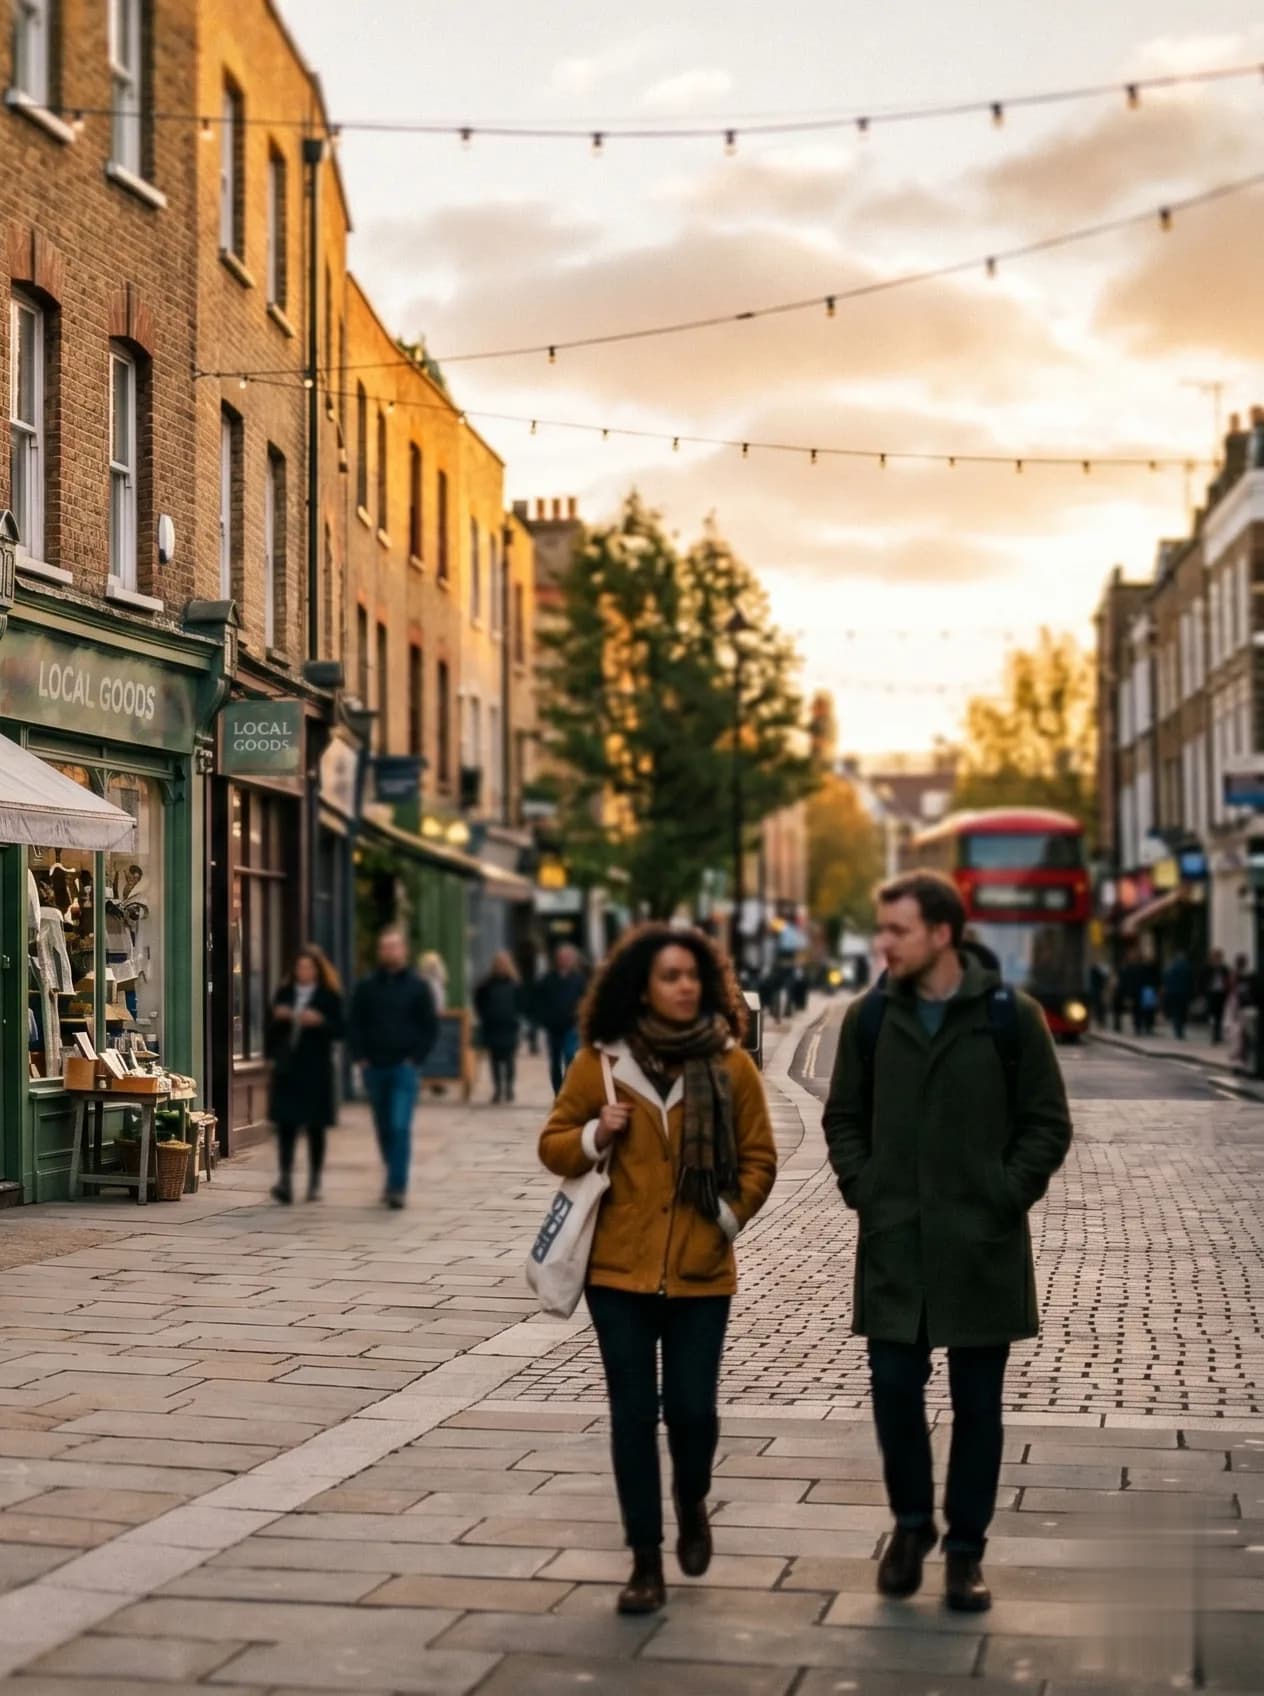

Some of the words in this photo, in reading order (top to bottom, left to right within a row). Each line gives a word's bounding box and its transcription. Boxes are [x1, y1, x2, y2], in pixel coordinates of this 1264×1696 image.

[38, 661, 95, 709] LOCAL
[99, 677, 156, 721] GOODS
[233, 722, 292, 735] LOCAL
[233, 739, 289, 752] GOODS
